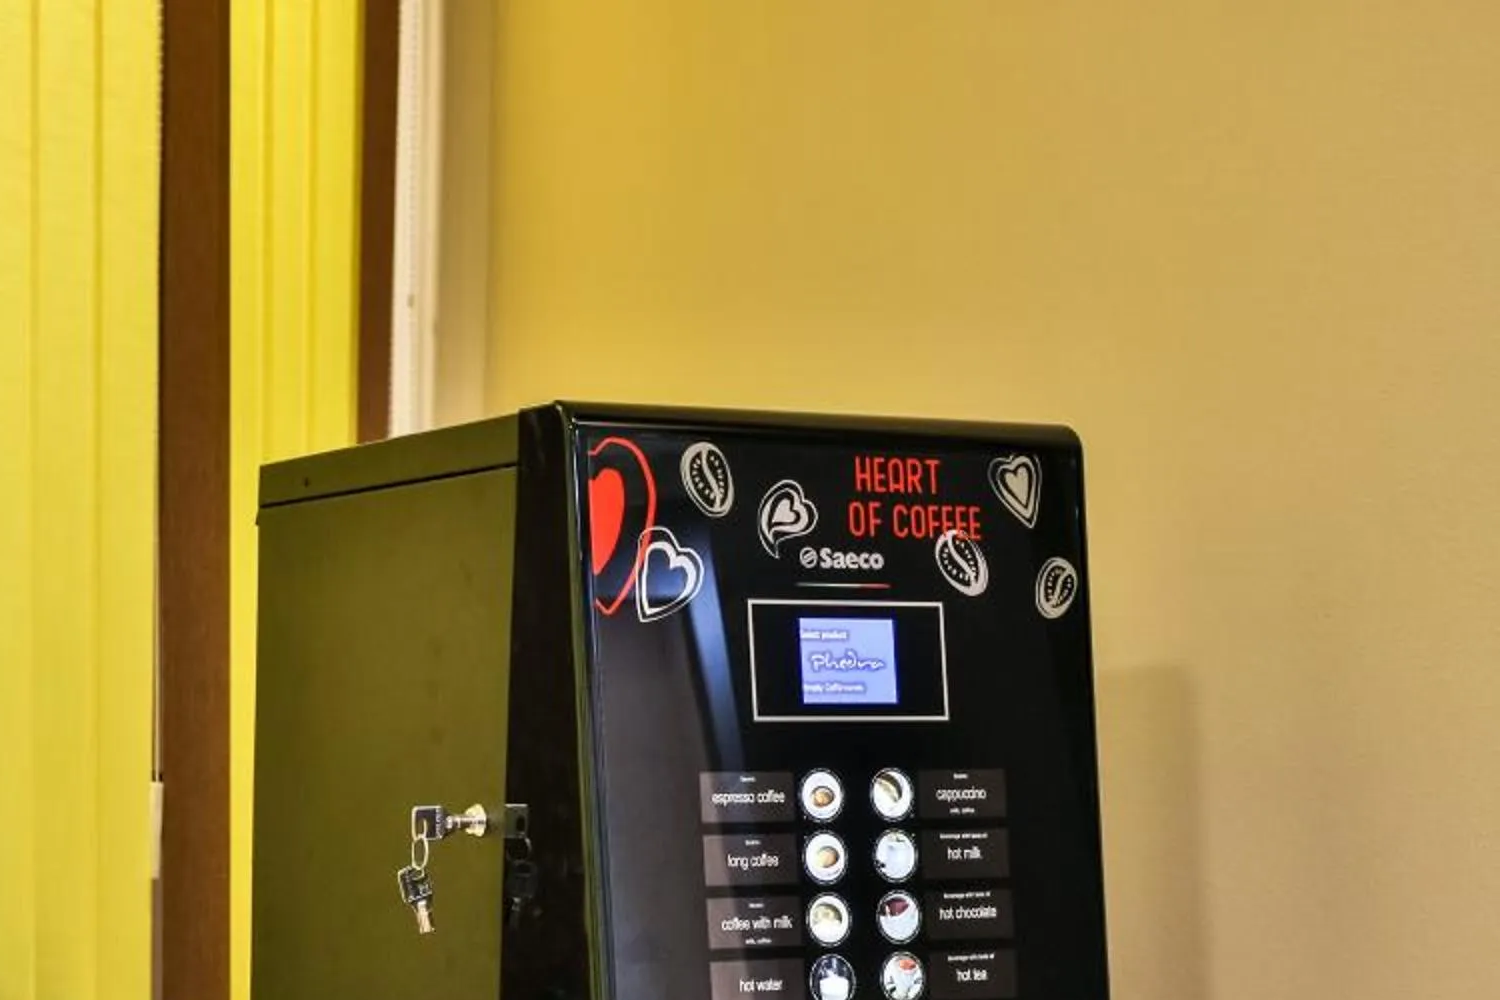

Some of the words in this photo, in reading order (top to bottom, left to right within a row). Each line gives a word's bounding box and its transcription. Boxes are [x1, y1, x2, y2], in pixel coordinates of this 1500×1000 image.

[854, 455, 941, 495] HEART
[848, 500, 884, 538] OF
[892, 504, 982, 541] COFFEE
[819, 546, 885, 570] Saeco
[947, 846, 962, 860] hot
[727, 853, 749, 871] long
[939, 906, 954, 921] hot
[956, 968, 971, 982] hot
[739, 979, 754, 993] hot
[755, 977, 783, 992] water
